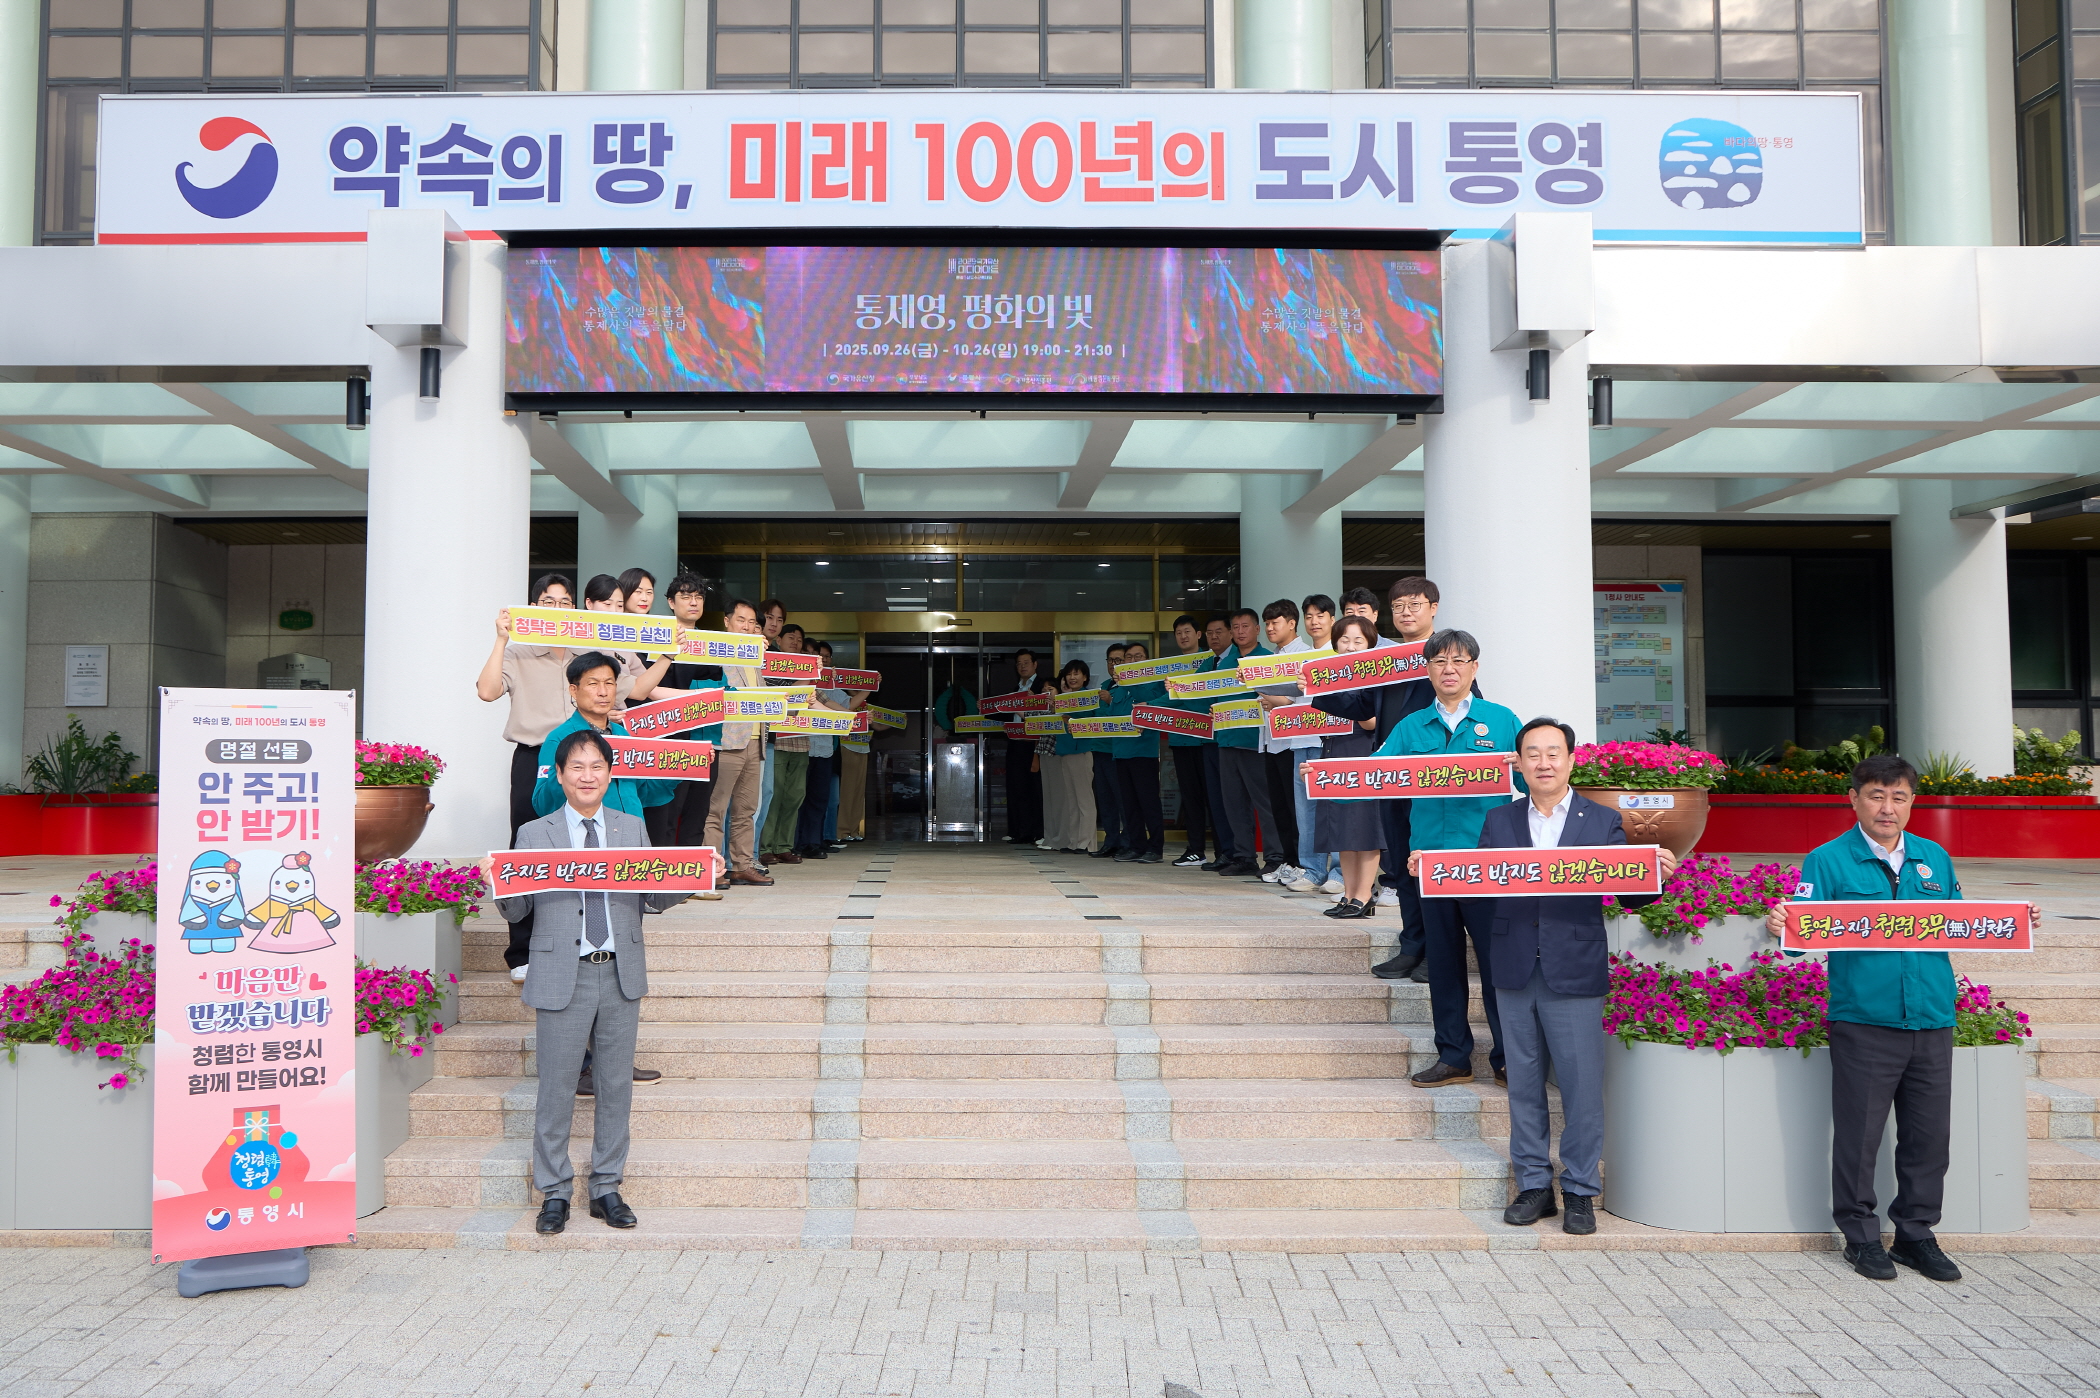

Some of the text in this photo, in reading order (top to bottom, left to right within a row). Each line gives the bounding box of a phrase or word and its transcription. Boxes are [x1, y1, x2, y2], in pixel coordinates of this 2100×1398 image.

[329, 120, 1604, 210] 약속의 땅, 미래 100년의 도시 통영
[854, 294, 1093, 331] 통제영, 평화의 빛
[835, 343, 938, 358] 2025.09.26(금)
[953, 343, 1018, 358] 10.26(일)
[1023, 344, 1060, 356] 19:00
[1074, 344, 1112, 356] 21:30
[1624, 593, 1645, 601] 안내도
[515, 617, 671, 645] 청탁은 거절! 청렴은 실천!
[708, 641, 735, 657] 청렴은
[737, 643, 759, 660] 실천!
[770, 658, 814, 673] 않겠습니다
[1243, 661, 1300, 681] 청탁은 거절!
[1310, 653, 1427, 687] 통영은 지금 청렴 3무(無) 실천
[630, 700, 724, 734] 주지도 받지도 않겠습니다
[740, 701, 763, 715] 청렴은
[764, 701, 783, 715] 실천!
[1135, 709, 1209, 732] 주지도 받지도 않겠습니다
[1274, 714, 1292, 731] 통영은
[1301, 711, 1317, 728] 청렴
[192, 716, 326, 727] 약속의 땅, 미래 100년의 도시 통영
[792, 716, 810, 728] 거절!
[811, 717, 833, 729] 청렴은
[220, 741, 299, 760] 명절 선물
[623, 748, 655, 769] 받지도
[658, 749, 709, 772] 않겠습니다
[198, 771, 319, 804] 안 주고!
[1315, 764, 1502, 790] 주지도 받지도 않겠습니다
[196, 808, 320, 842] 안 받기!
[500, 858, 705, 884] 주지도 받지도 않겠습니다
[1431, 857, 1648, 885] 주지도 받지도 않겠습니다
[1798, 913, 2016, 940] 통영은 지금 청렴 3무(無) 실천중
[215, 965, 303, 995] 마음만
[188, 996, 330, 1031] 받겠습니다
[192, 1038, 323, 1067] 청렴한 통영시
[188, 1066, 326, 1096] 함께 만들어요!
[241, 1167, 270, 1188] 통영
